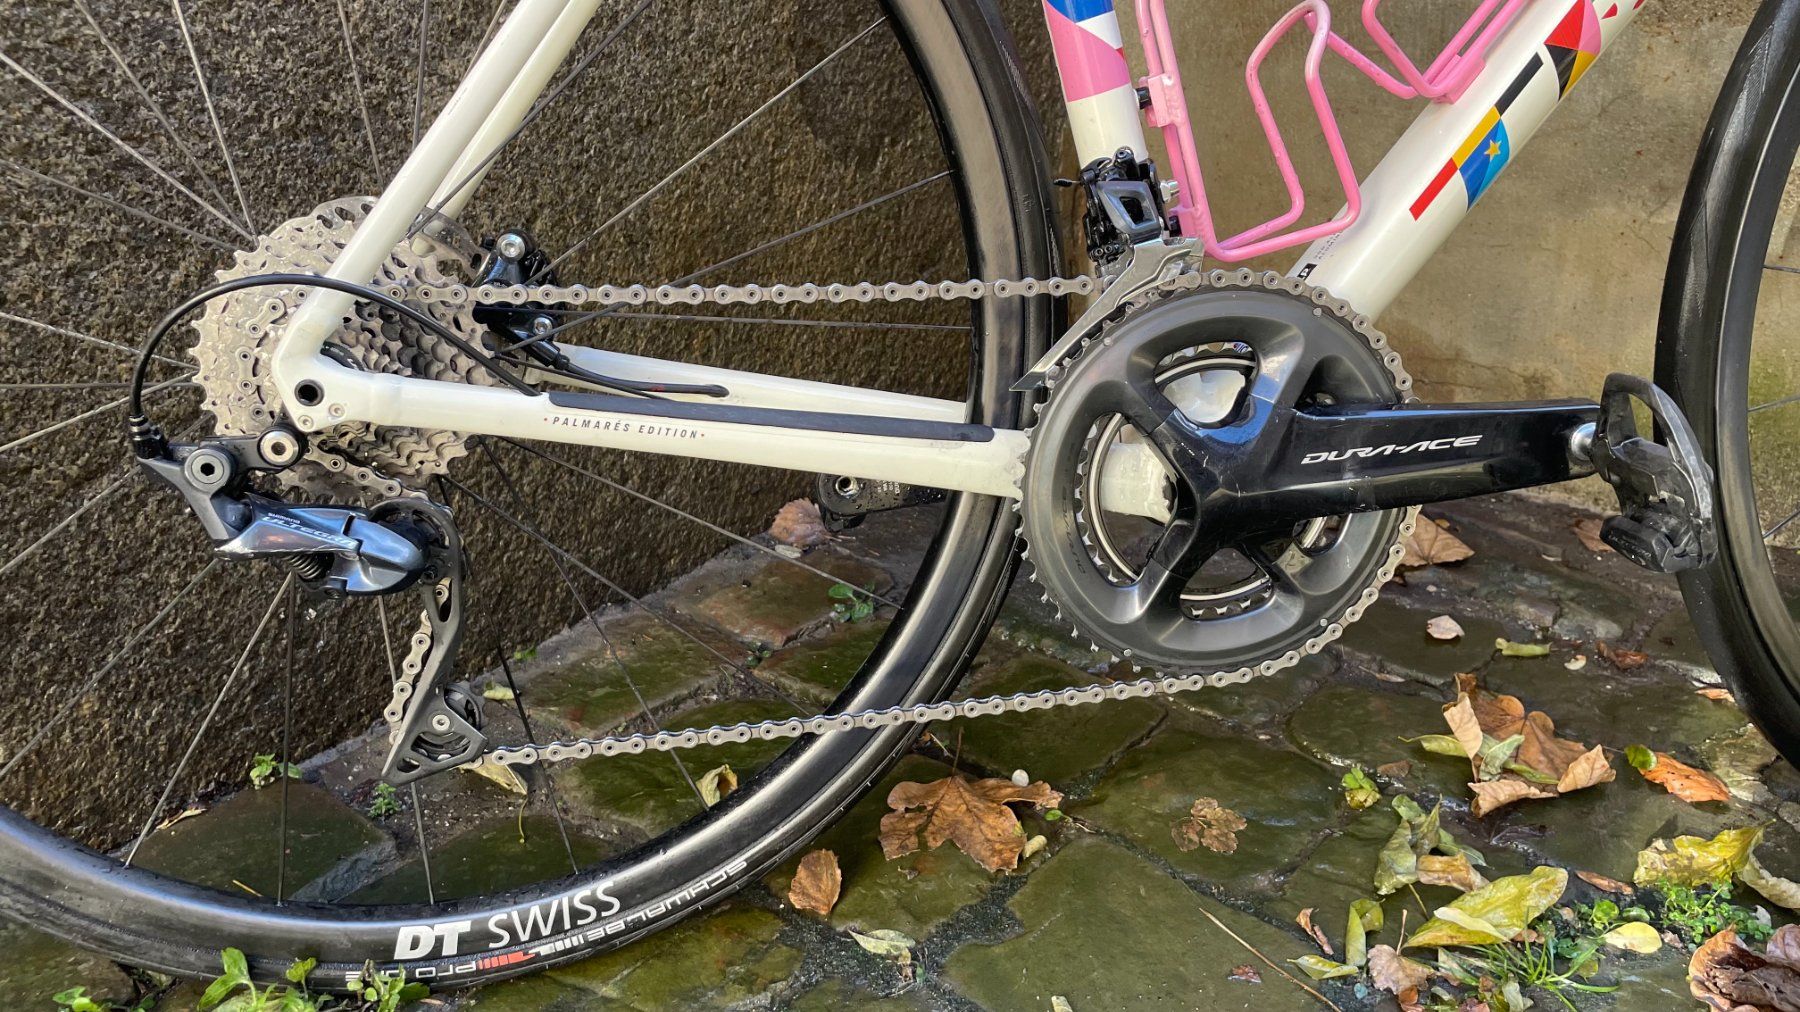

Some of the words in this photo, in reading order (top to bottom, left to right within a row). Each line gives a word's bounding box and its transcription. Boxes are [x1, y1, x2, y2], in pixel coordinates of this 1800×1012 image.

[552, 416, 631, 432] PALMARÉS
[638, 424, 699, 439] EDITION
[1300, 434, 1484, 465] DURA-ACE
[393, 920, 472, 961] DT
[487, 880, 622, 949] SWISS
[587, 860, 748, 942] SCHWALBE
